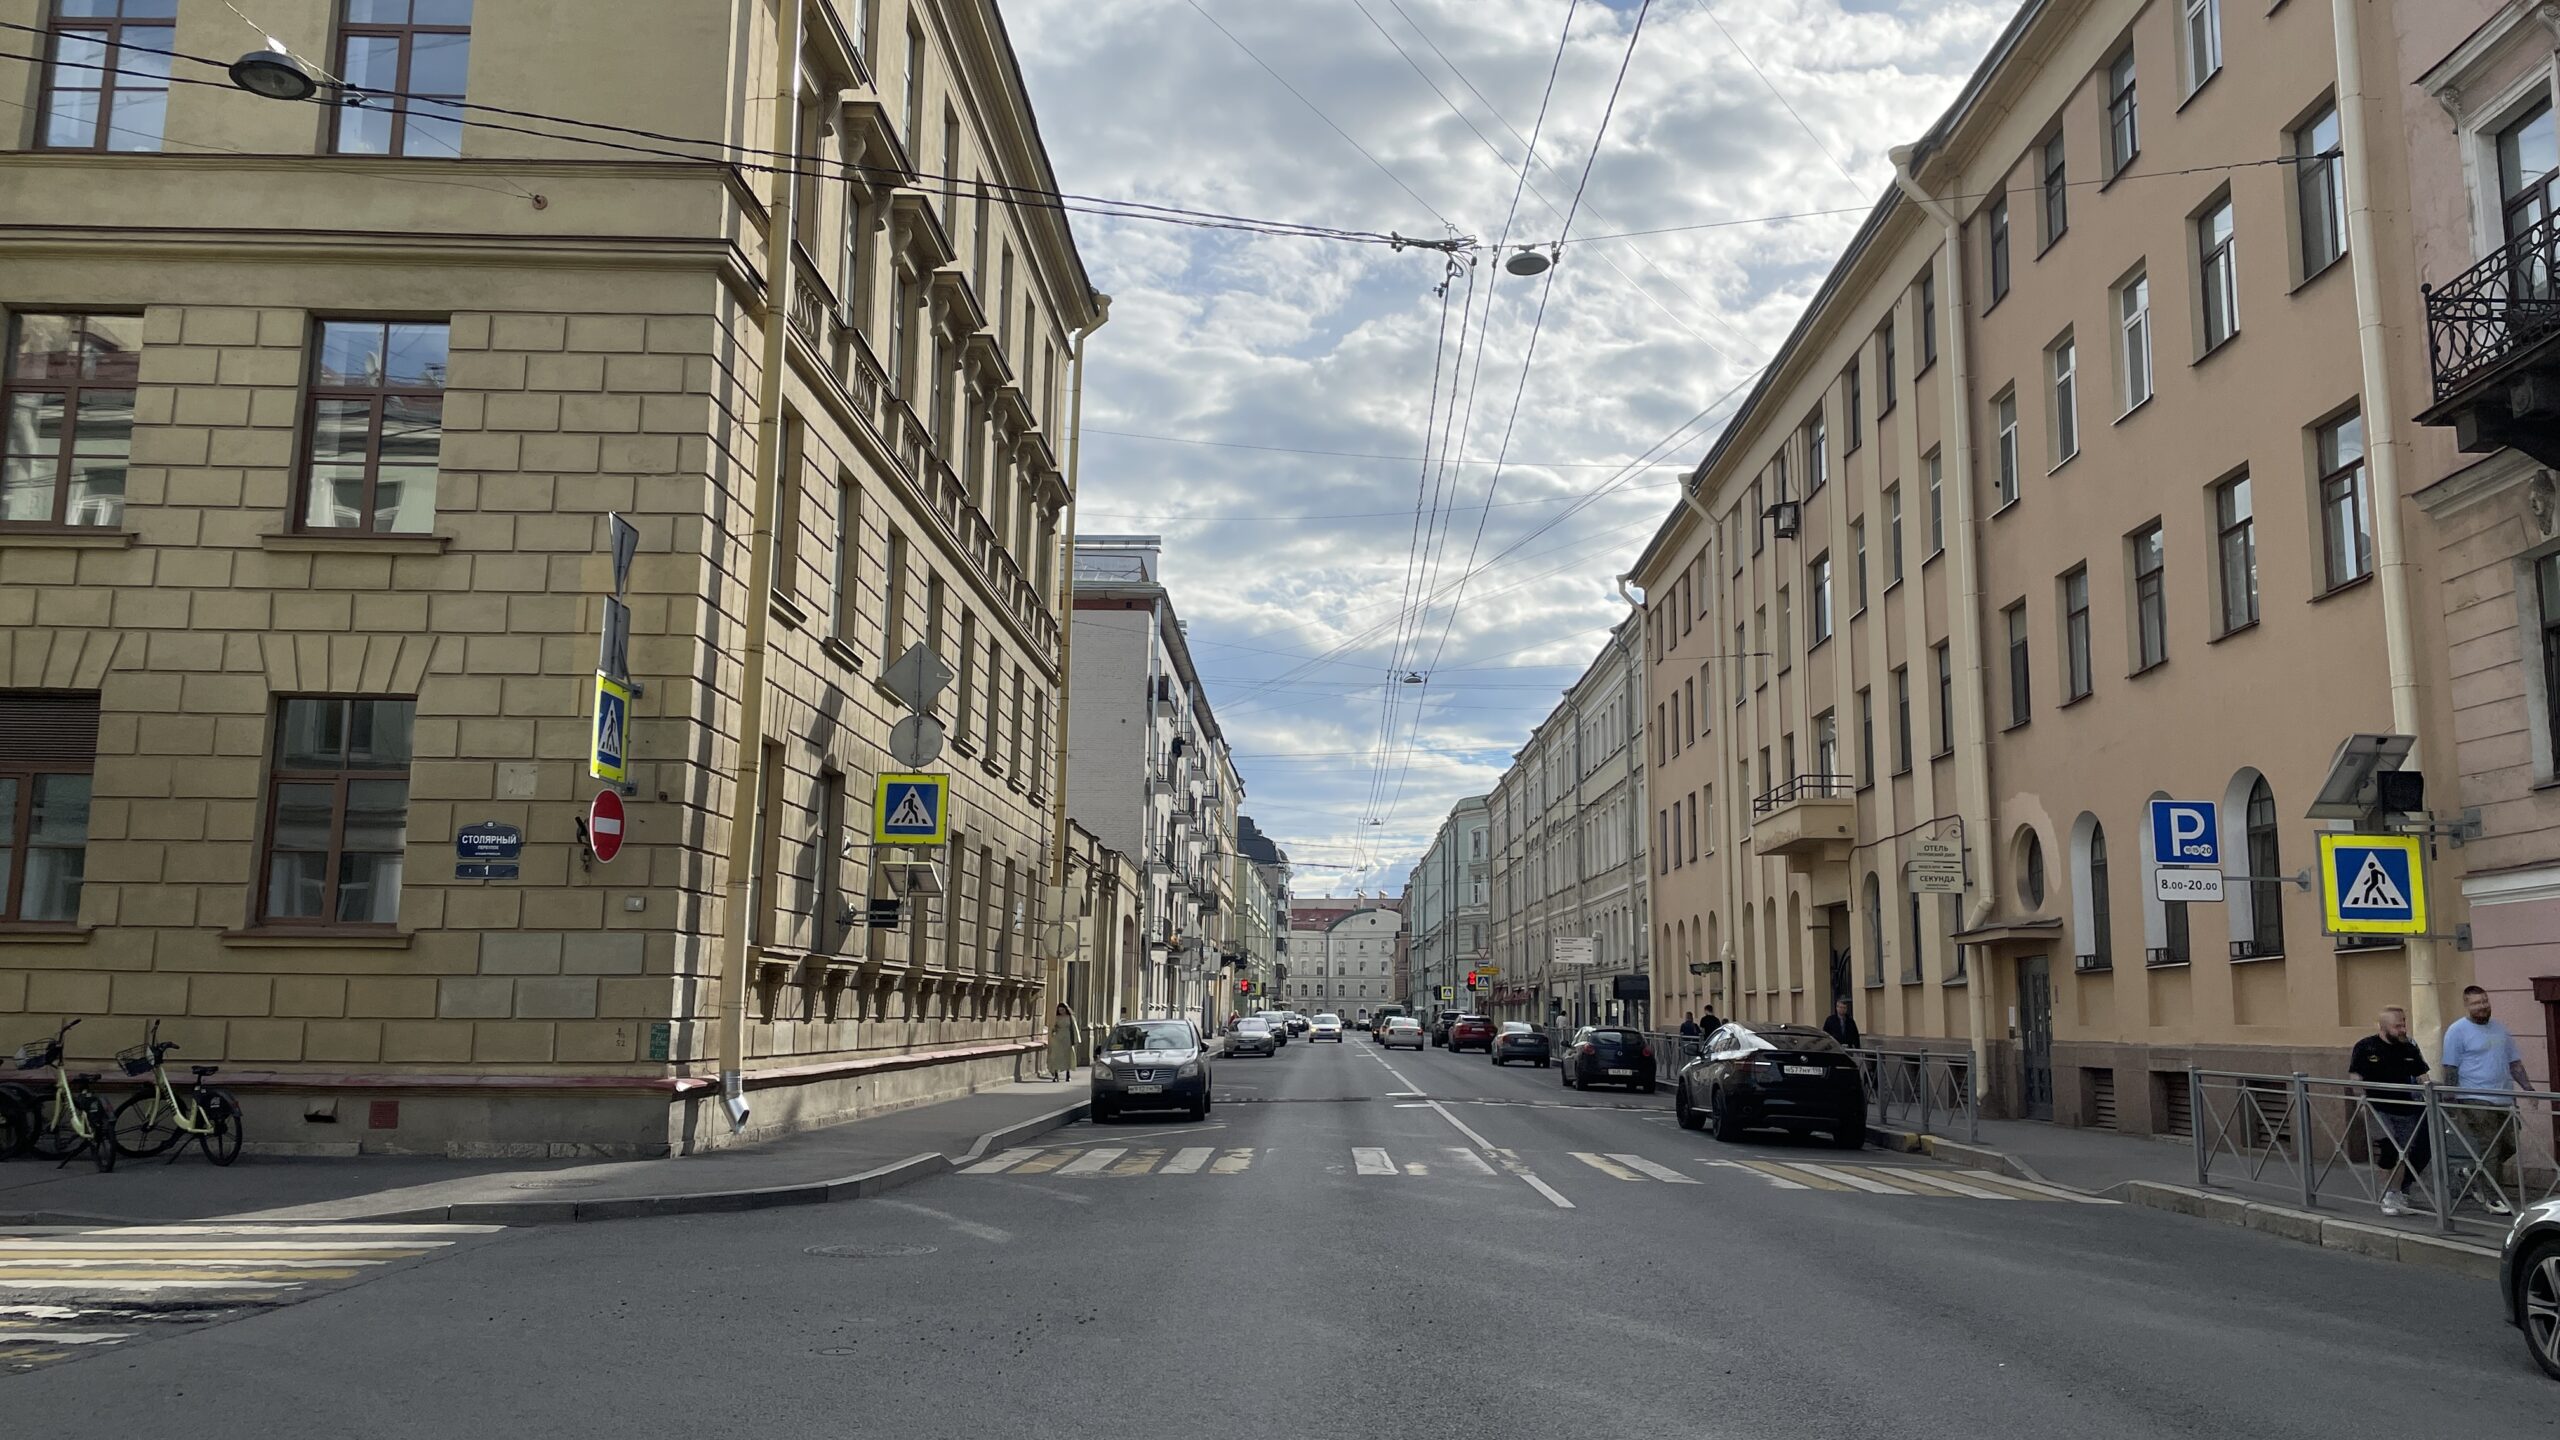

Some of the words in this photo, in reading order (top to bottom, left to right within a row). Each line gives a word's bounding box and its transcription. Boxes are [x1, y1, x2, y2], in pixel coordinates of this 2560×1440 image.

[2169, 808, 2205, 857] P
[462, 834, 516, 844] СТОЛЯРНЫЙ
[2201, 846, 2212, 855] 20
[484, 865, 489, 876] 1
[1919, 875, 1956, 883] СЕКУНДА
[2161, 879, 2218, 891] 8.00-20.00
